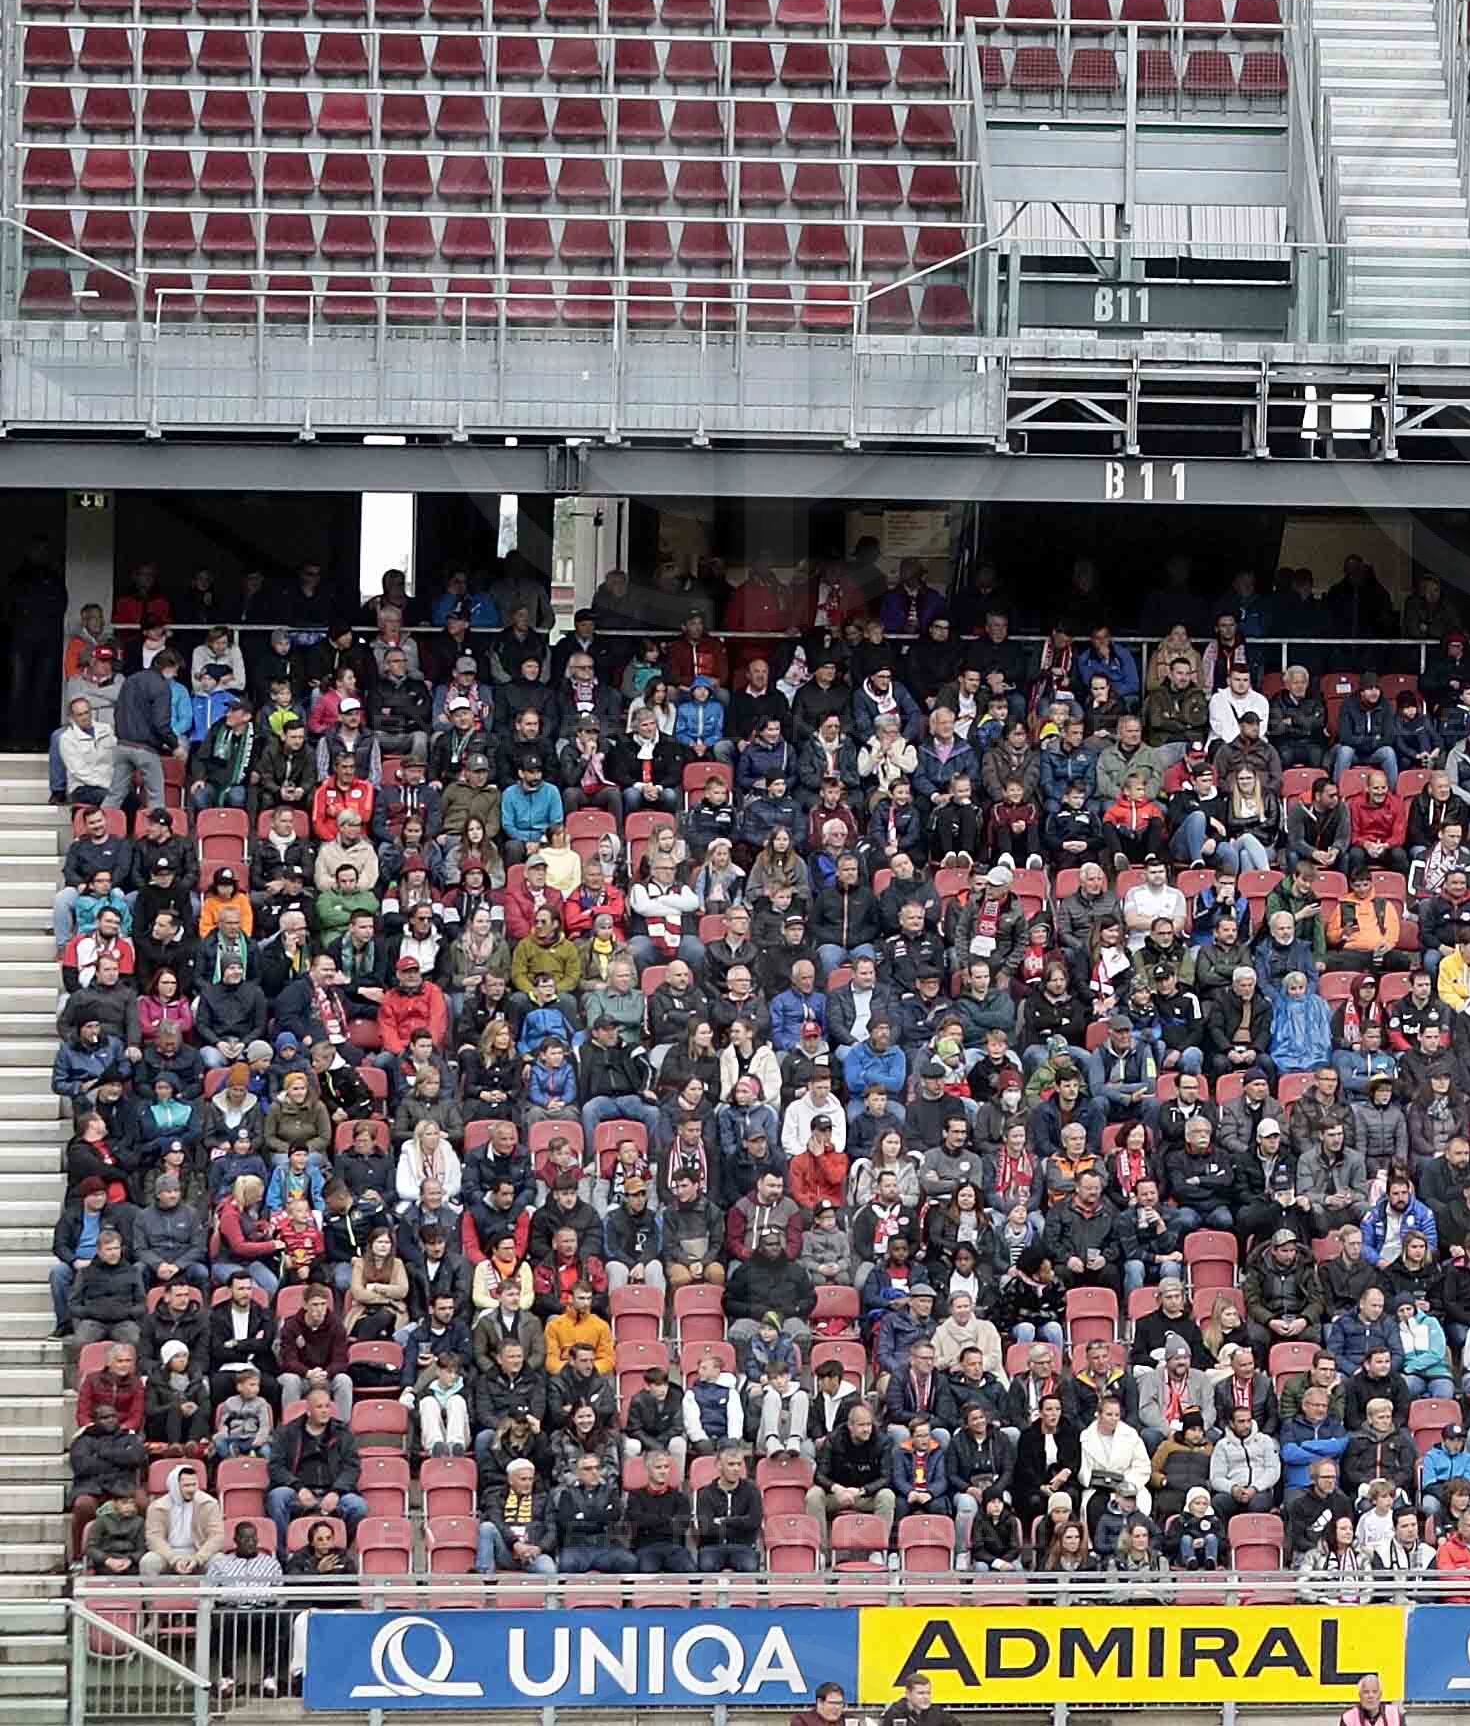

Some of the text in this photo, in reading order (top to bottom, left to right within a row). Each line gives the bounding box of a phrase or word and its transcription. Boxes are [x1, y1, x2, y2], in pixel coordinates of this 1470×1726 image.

[1092, 286, 1151, 325] B11
[508, 1624, 807, 1696] UNIQA
[894, 1619, 1379, 1686] ADMIRAL
